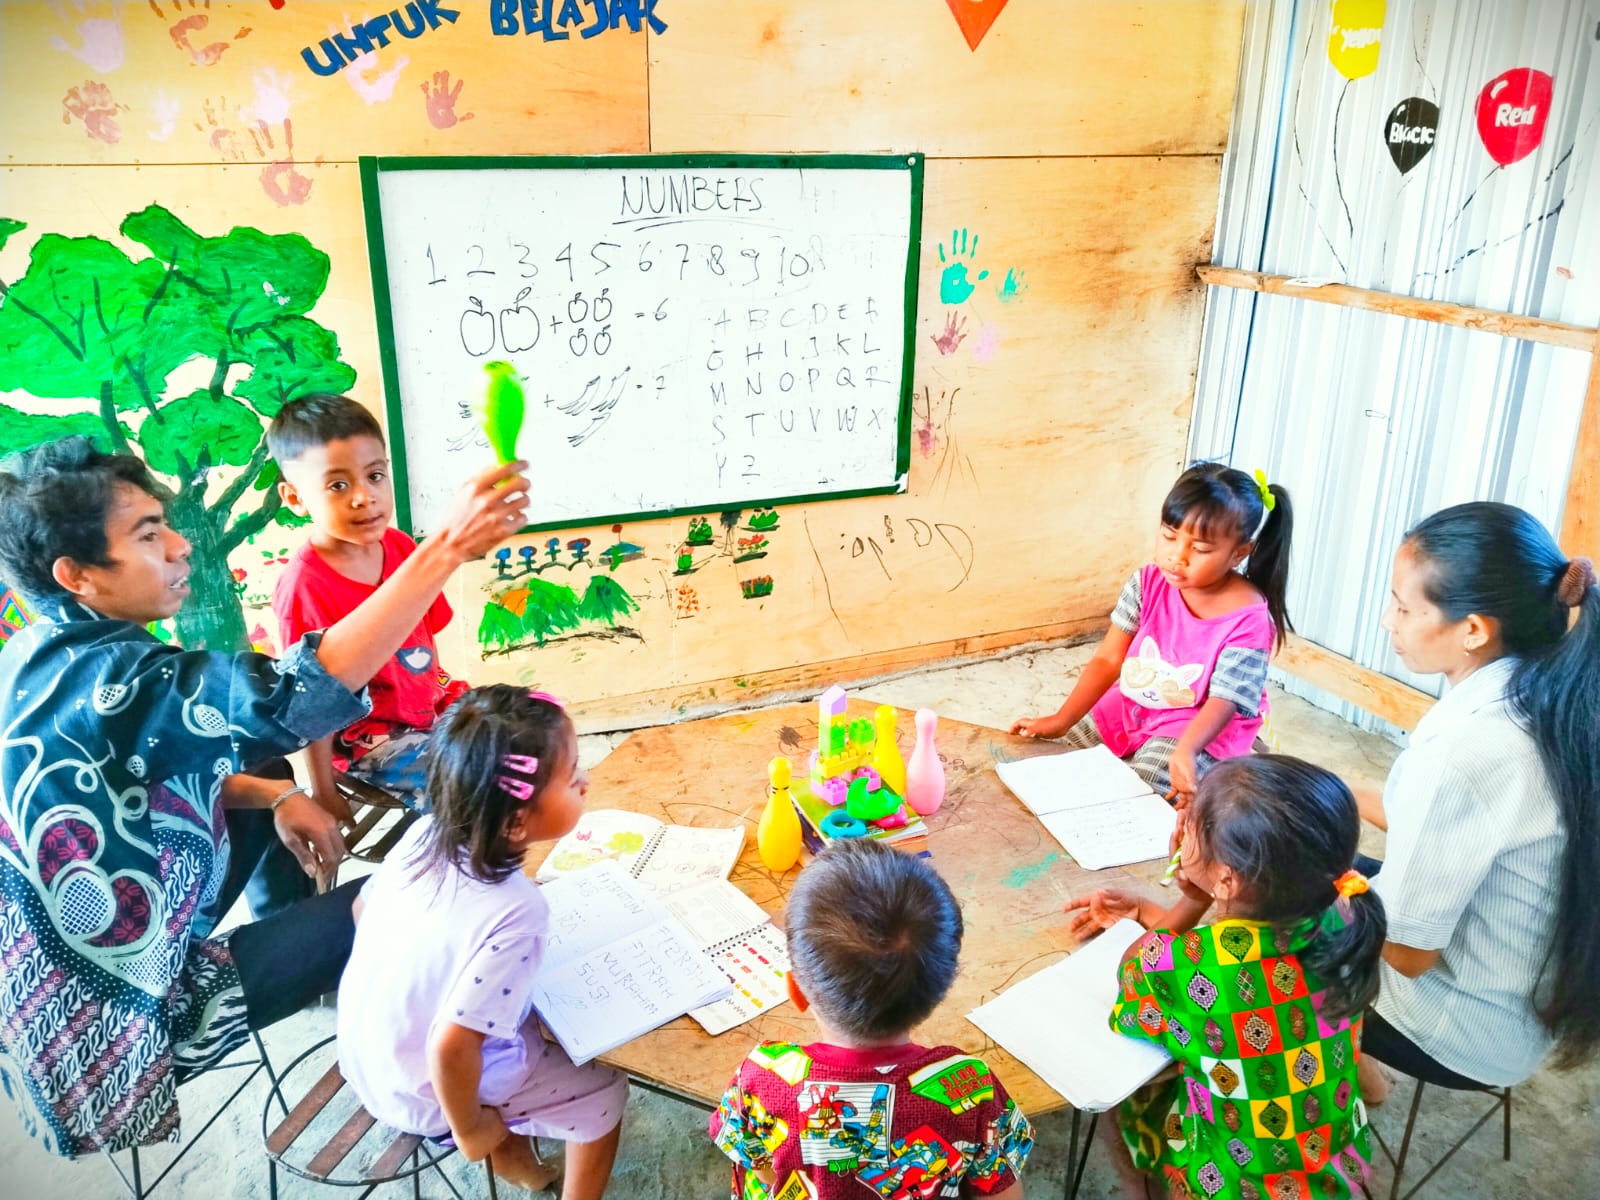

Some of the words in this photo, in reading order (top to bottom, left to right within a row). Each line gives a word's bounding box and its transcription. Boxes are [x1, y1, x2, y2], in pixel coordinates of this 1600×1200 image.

[300, 0, 461, 76] UNTUK
[1495, 103, 1537, 127] Red
[620, 174, 764, 215] NUMBERS
[426, 242, 447, 285] 1
[466, 244, 496, 278] 2
[514, 244, 539, 278] 3
[555, 242, 573, 282] 4
[590, 241, 622, 275] 5
[638, 240, 653, 272] 6
[675, 243, 689, 280] 7
[709, 244, 725, 276] 8
[777, 246, 810, 287] 10
[654, 297, 669, 321] 6
[779, 307, 797, 328] C
[745, 342, 764, 366] H
[836, 332, 852, 356] K
[863, 332, 881, 354] L
[710, 381, 727, 407] M
[746, 371, 762, 396] N
[807, 367, 821, 393] P
[835, 366, 857, 389] Q
[711, 414, 726, 446] S
[744, 412, 765, 437] T
[779, 409, 795, 433] U
[808, 406, 821, 433] V
[837, 406, 858, 432] W
[866, 407, 885, 431] X
[715, 451, 728, 489] Y
